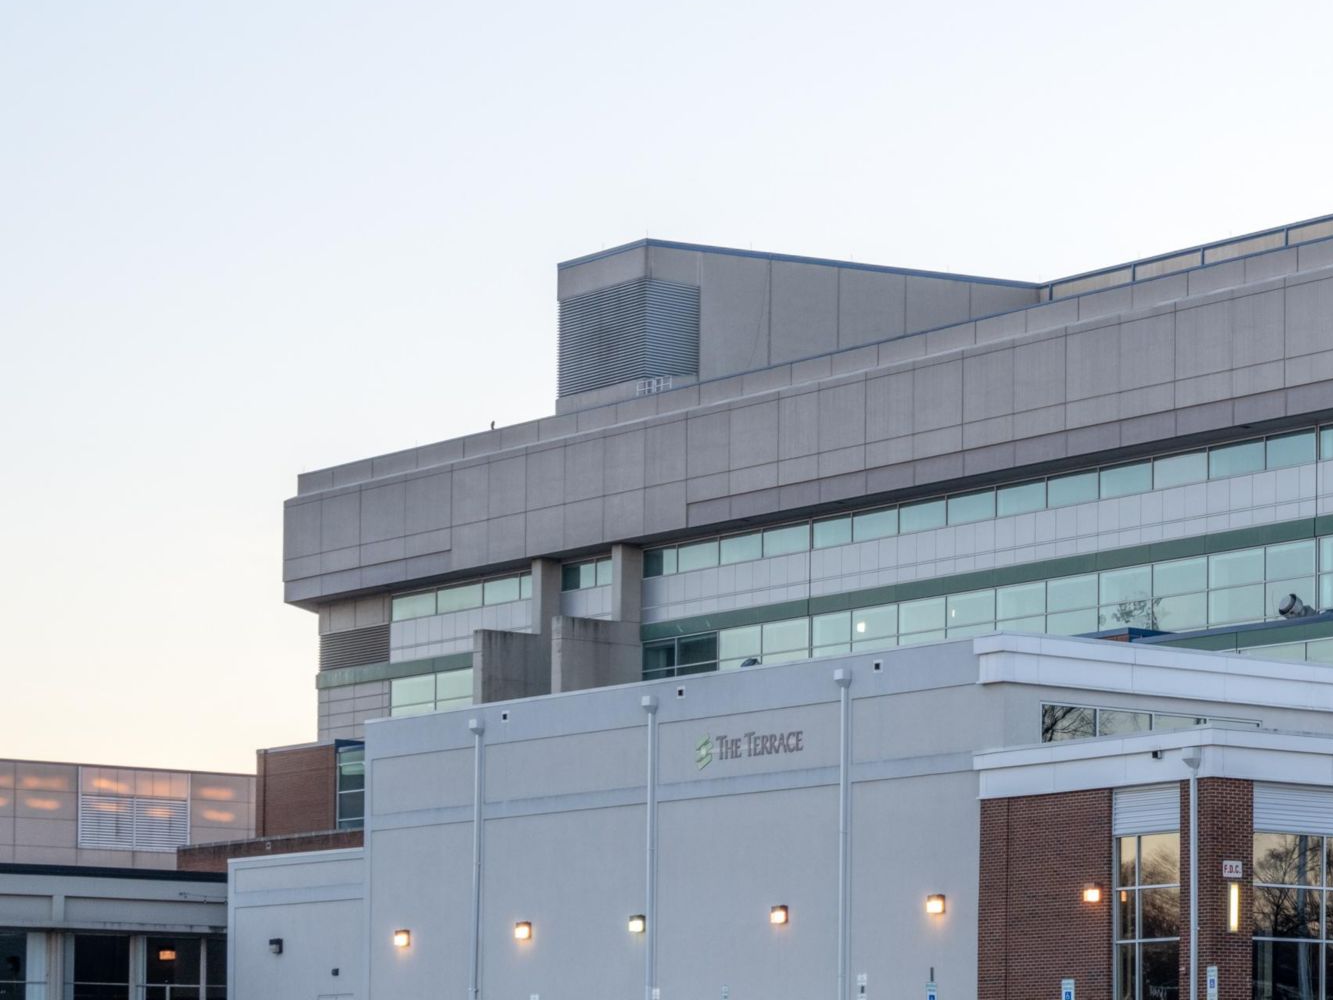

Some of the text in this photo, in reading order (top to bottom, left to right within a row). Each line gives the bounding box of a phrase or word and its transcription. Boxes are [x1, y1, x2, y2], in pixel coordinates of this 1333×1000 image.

[715, 731, 804, 760] THE TERRACE
[1223, 864, 1242, 874] F.D.C.
